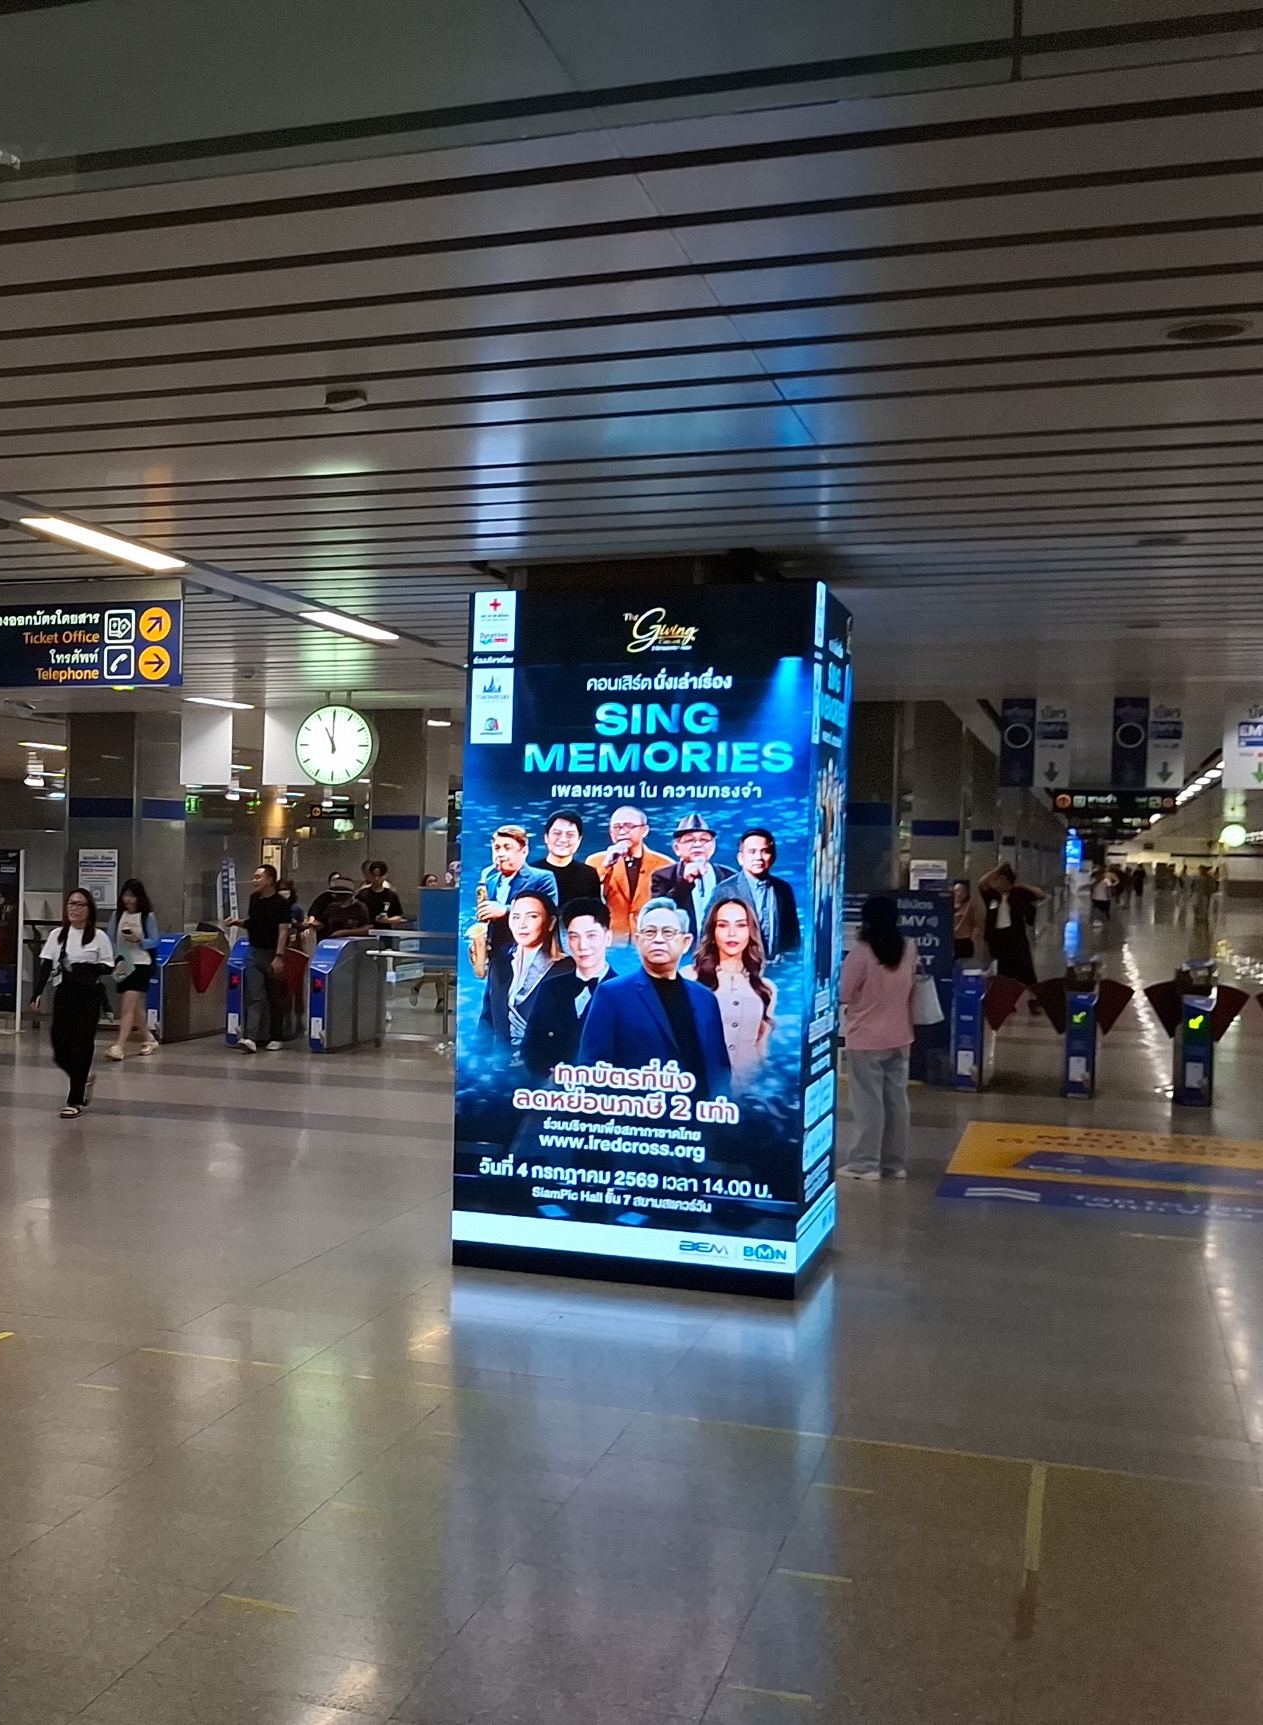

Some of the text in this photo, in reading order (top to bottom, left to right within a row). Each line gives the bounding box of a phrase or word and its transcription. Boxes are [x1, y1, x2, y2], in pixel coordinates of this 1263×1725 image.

[22, 630, 101, 645] Ticket Office
[49, 648, 100, 665] โทรศัพท์
[36, 667, 100, 683] Telephone
[594, 702, 719, 736] SING
[1240, 724, 1263, 737] EM
[523, 740, 795, 774] MEMORIES
[550, 780, 762, 799] เพลงหวาน ใน ความทรงจำ
[556, 1059, 695, 1092] ทุกบัตรที่นั่ง
[514, 1088, 738, 1123] ลดหย่อนภาษี 2 เท่า
[539, 1133, 706, 1163] www.iredcross.org
[479, 1154, 773, 1200] วันที่ 4 กรกฎาคม 2569 เวลา 14.00 น.
[531, 1187, 578, 1202] SiamPic
[580, 1190, 603, 1203] Hall
[623, 1194, 631, 1205] 7
[743, 1243, 787, 1261] BMN
